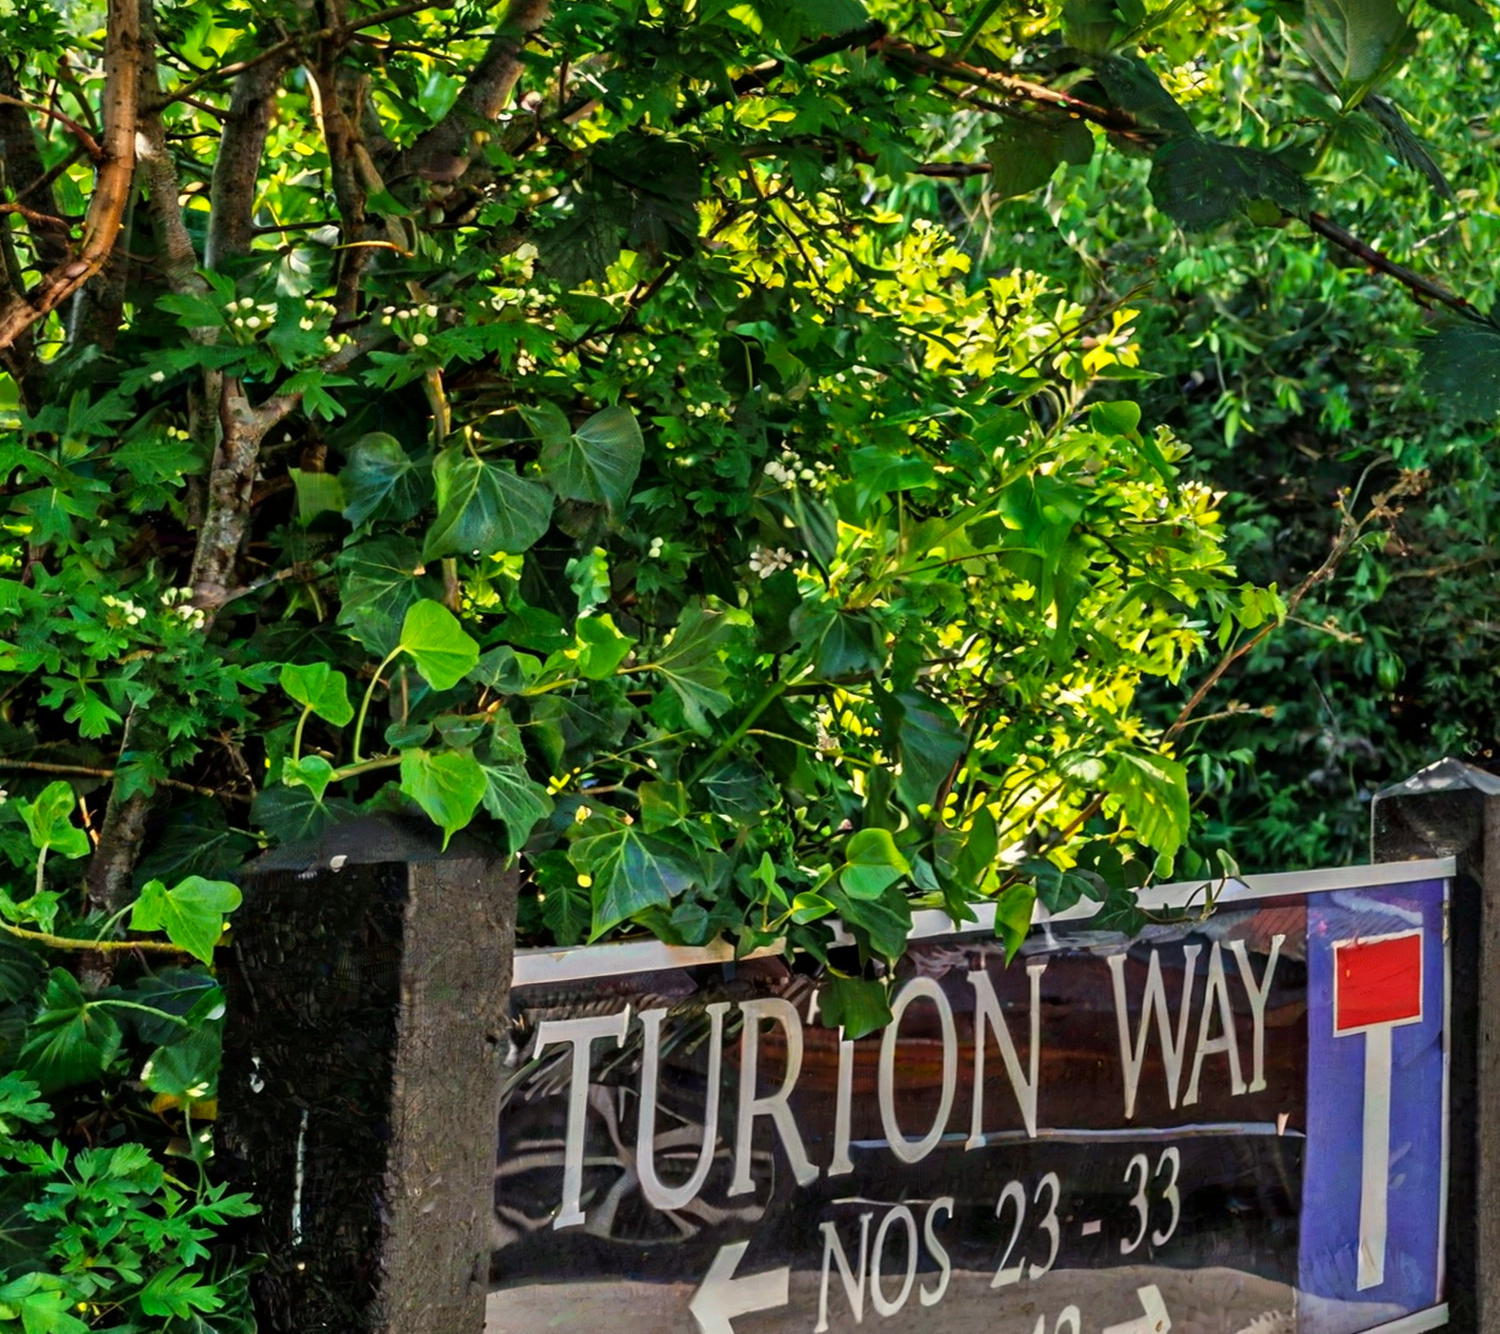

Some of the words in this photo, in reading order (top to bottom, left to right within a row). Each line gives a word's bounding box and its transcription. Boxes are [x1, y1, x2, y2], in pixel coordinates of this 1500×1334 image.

[533, 964, 1047, 1230] TURTON
[1107, 935, 1285, 1119] WAY
[814, 1197, 954, 1334] NOS
[990, 1171, 1060, 1288] 23
[1081, 1219, 1101, 1236] -
[1120, 1147, 1180, 1255] 33
